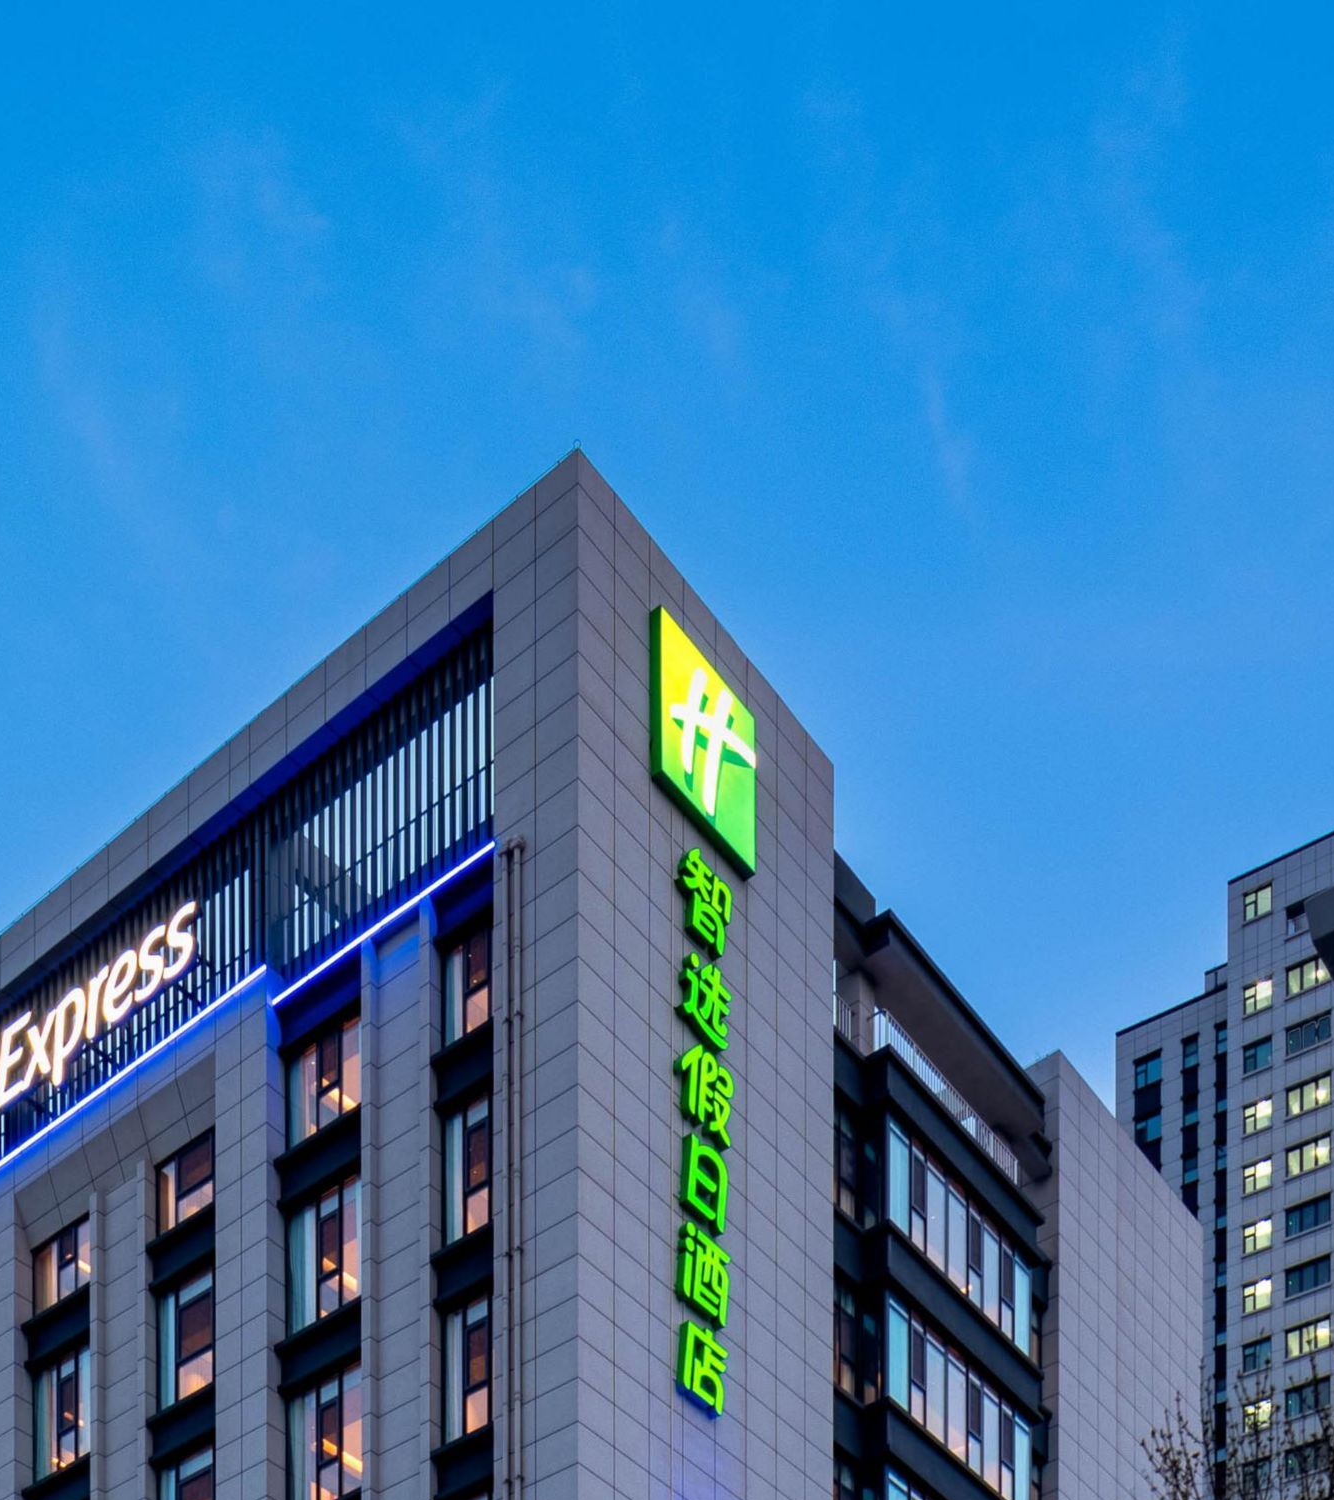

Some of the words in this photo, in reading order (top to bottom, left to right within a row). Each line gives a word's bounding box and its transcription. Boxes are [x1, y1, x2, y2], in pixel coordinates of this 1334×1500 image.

[676, 847, 734, 1416] 智选假日酒店
